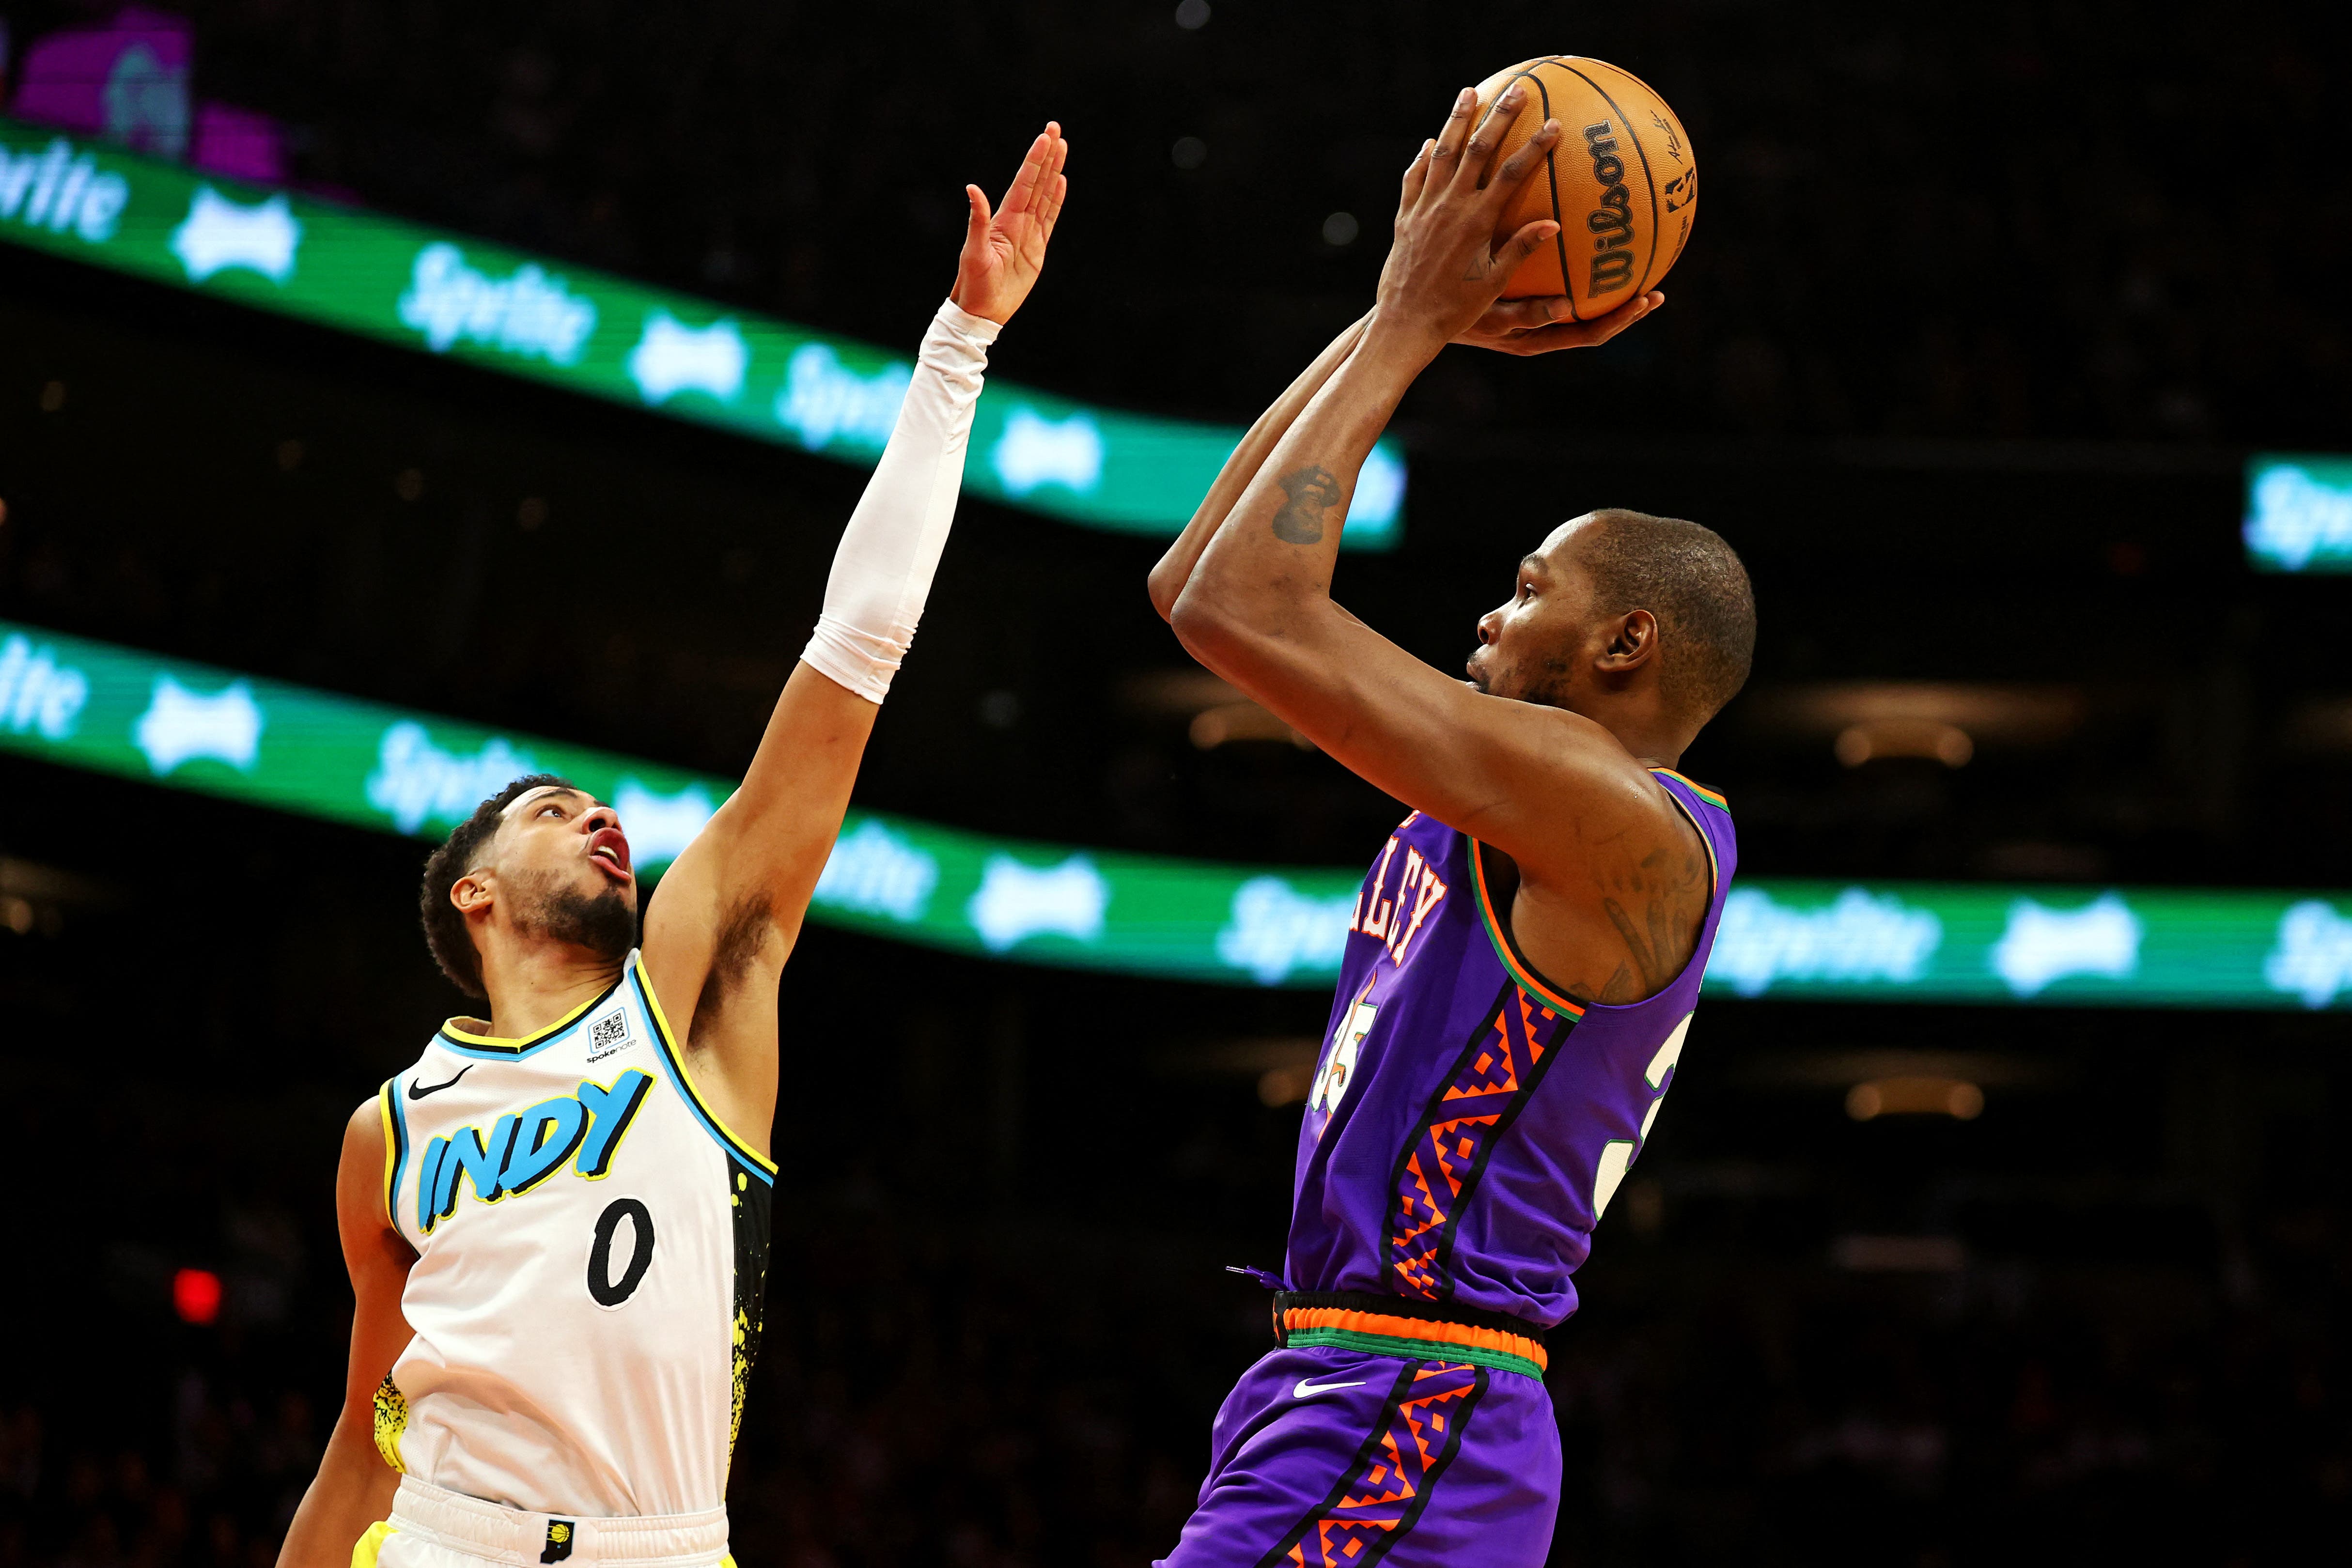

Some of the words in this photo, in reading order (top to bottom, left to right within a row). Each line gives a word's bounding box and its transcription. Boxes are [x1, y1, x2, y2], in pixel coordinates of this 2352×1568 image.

[1582, 119, 1635, 298] Wilson
[397, 242, 598, 367] Sprite
[586, 1039, 637, 1064] spokenote
[416, 1067, 658, 1236] INDY
[585, 1195, 657, 1310] 0
